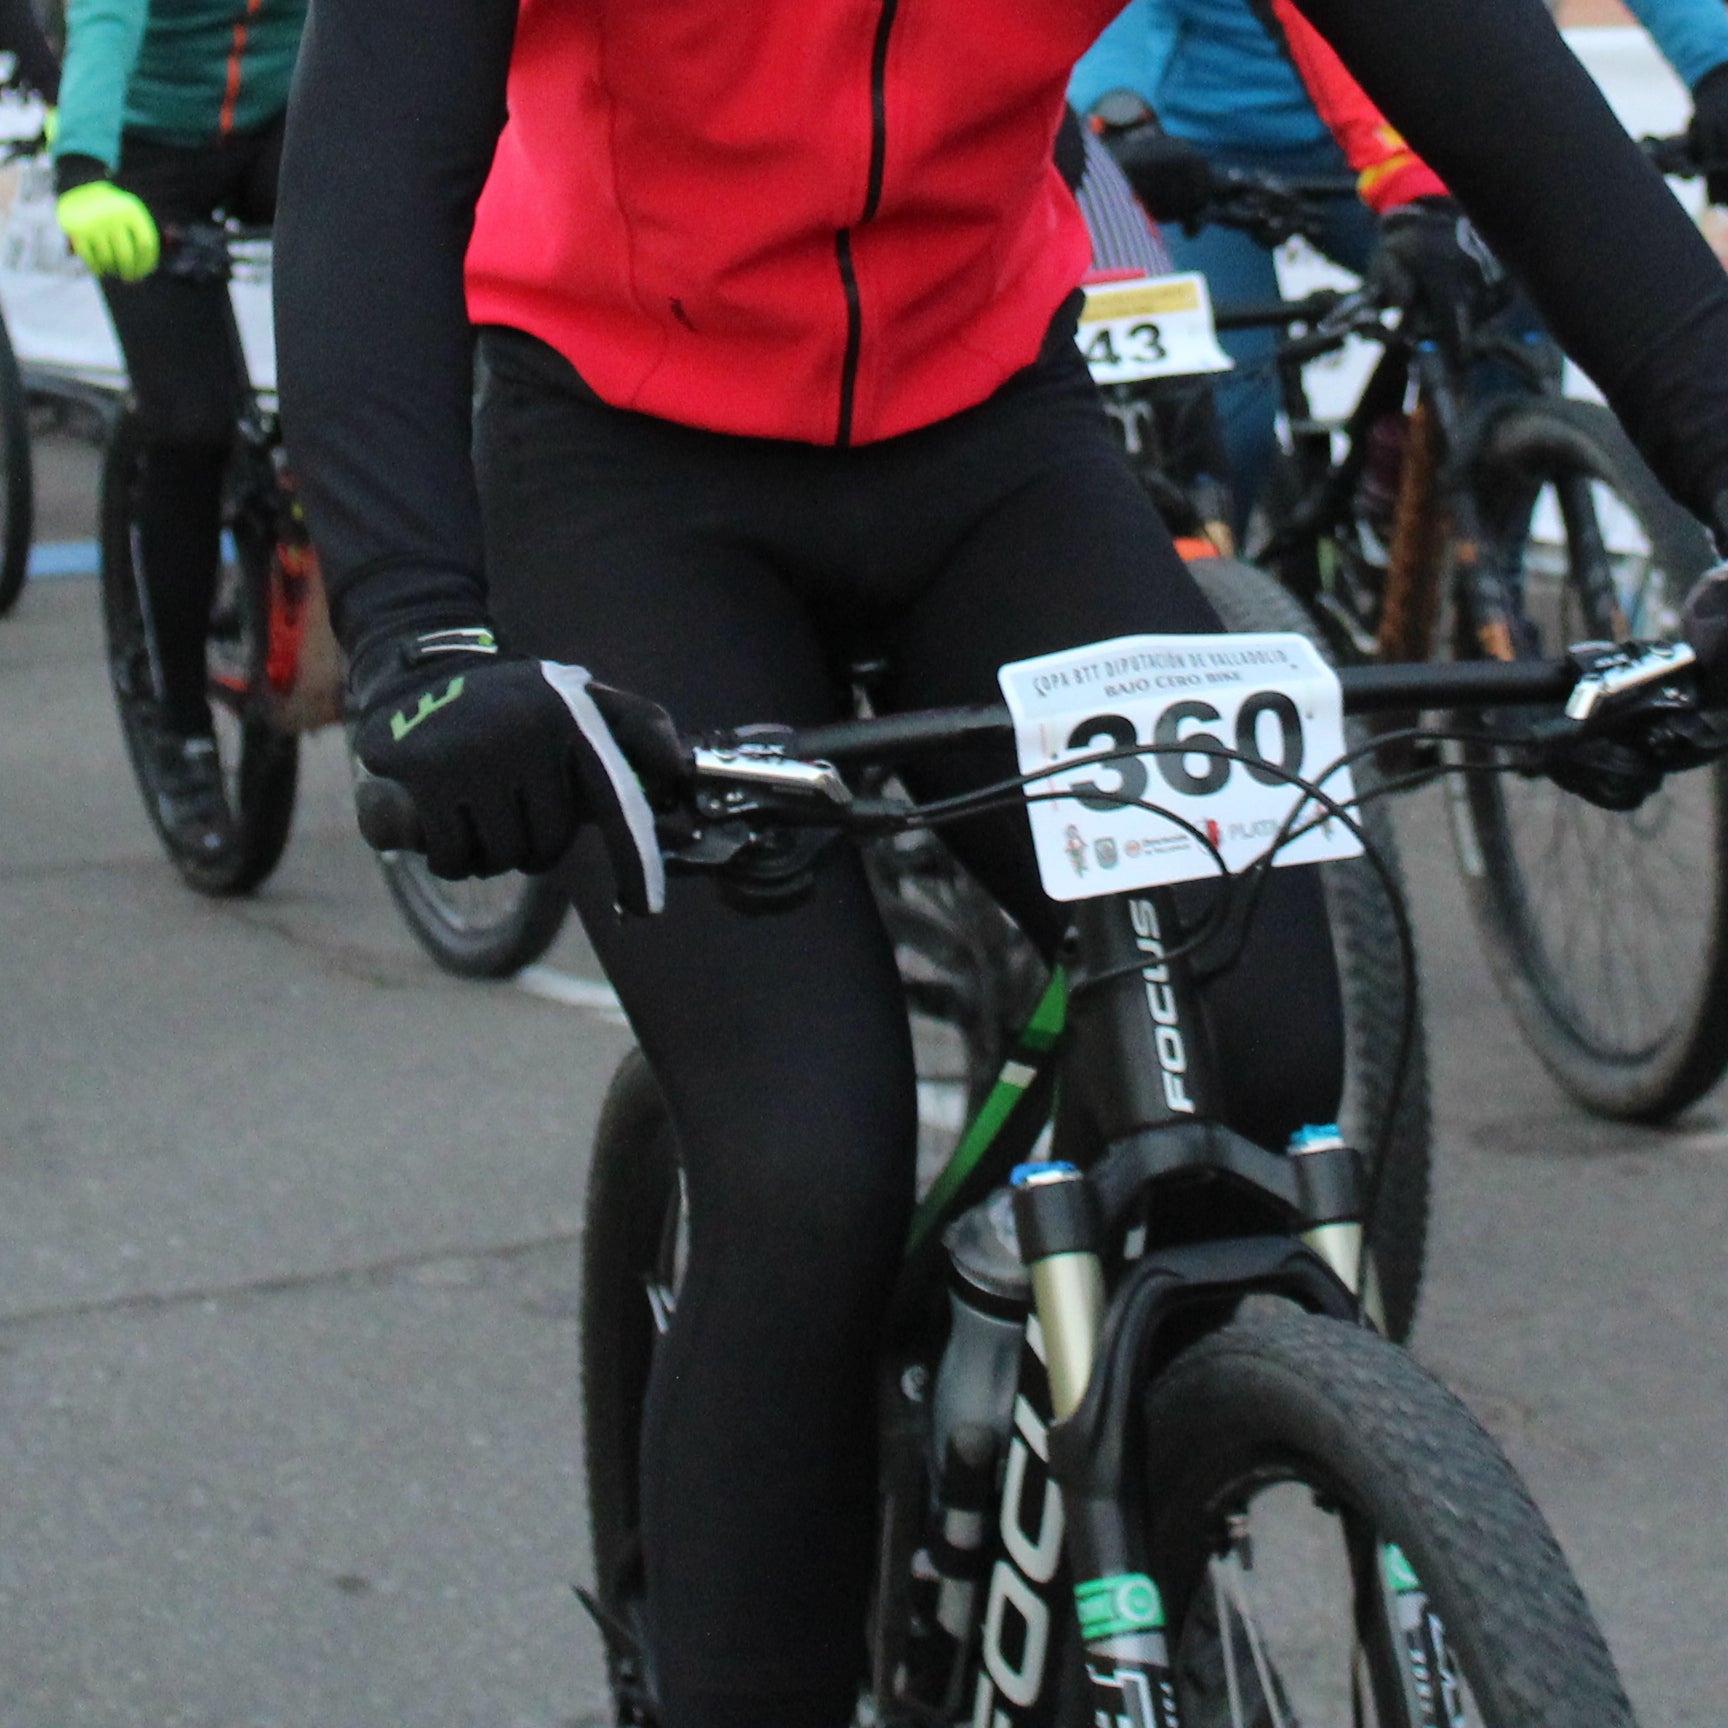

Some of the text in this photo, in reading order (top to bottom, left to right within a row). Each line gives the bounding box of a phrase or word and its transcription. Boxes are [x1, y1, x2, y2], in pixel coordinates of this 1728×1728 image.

[1103, 677, 1151, 698] BAJO
[1155, 672, 1201, 691] CERO
[1066, 689, 1305, 812] 360
[1128, 898, 1197, 1114] FOCUS
